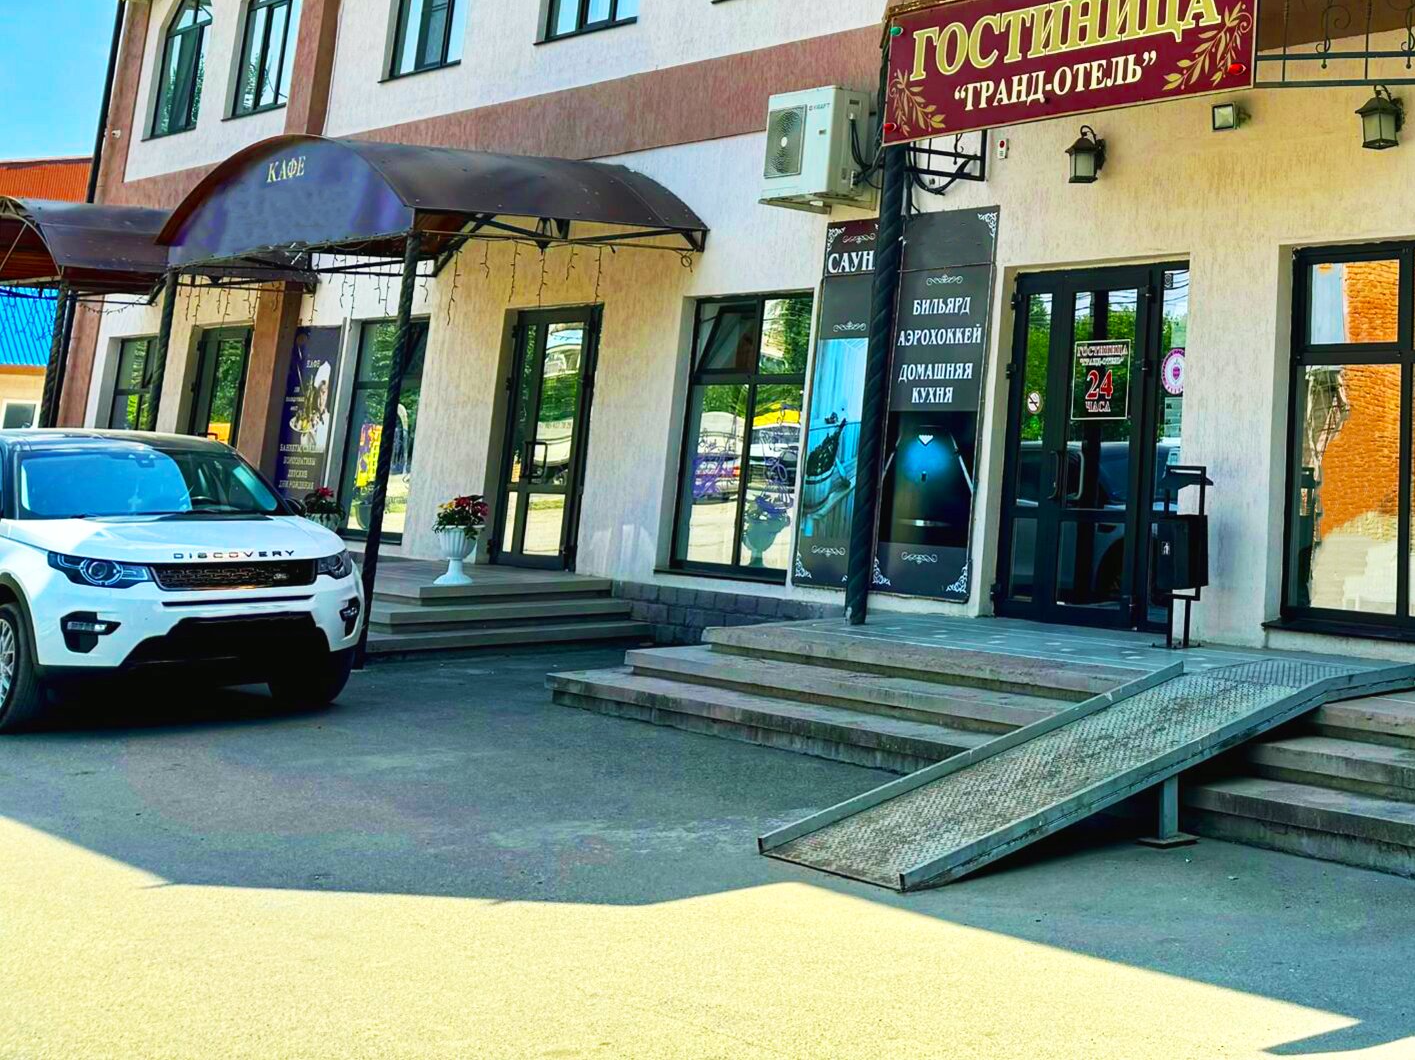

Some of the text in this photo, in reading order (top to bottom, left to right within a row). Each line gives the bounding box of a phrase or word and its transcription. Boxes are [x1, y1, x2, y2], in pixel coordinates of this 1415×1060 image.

[266, 156, 306, 183] КАФЕ
[827, 250, 876, 274] САУН
[912, 297, 971, 316] БИЛЬЯРД
[897, 323, 982, 346] АЭРОХОККЕЙ
[898, 362, 973, 384] ДОМАШНЯЯ
[911, 386, 953, 404] КУХНЯ
[1085, 369, 1113, 400] 24
[1085, 401, 1111, 413] ЧАСА
[173, 550, 294, 559] DISCOVERY
